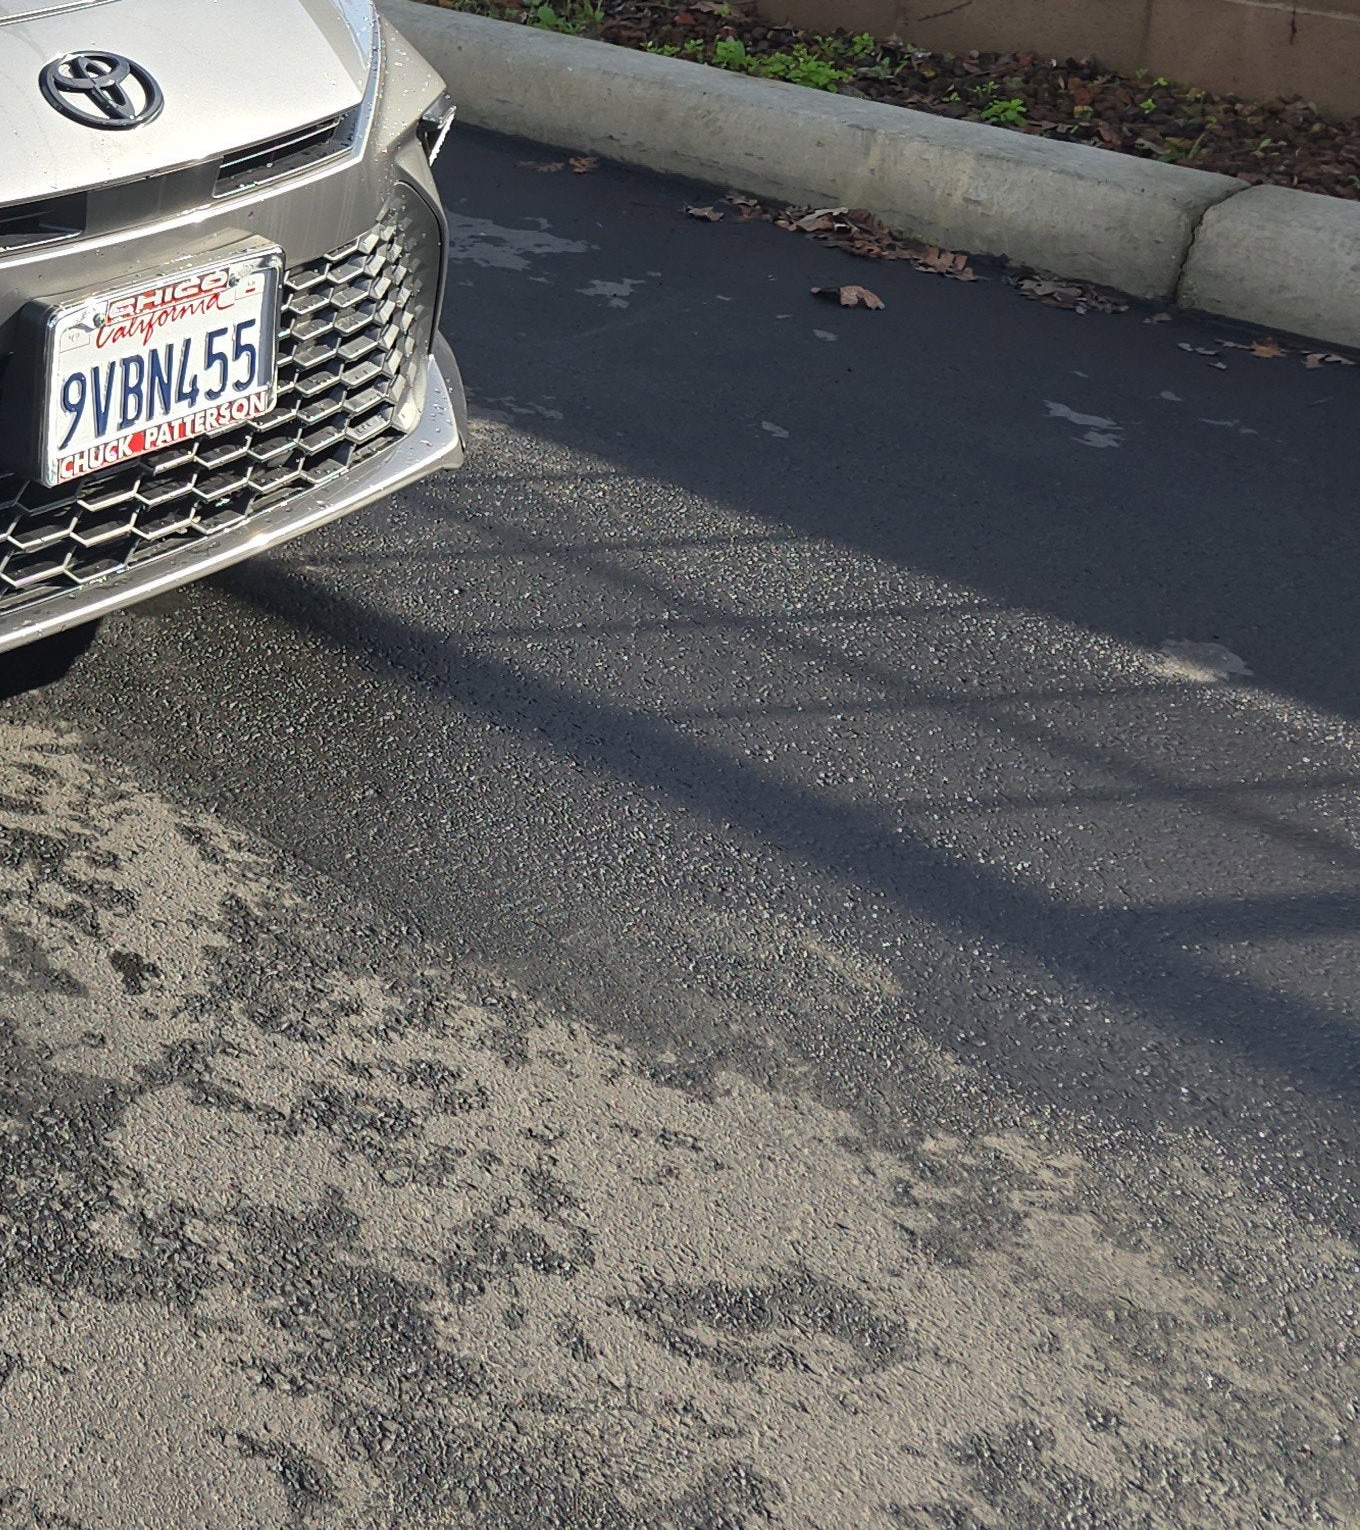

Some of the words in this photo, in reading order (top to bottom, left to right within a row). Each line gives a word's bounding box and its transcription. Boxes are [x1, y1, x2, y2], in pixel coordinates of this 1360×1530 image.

[96, 293, 235, 348] California
[108, 273, 228, 319] CHICO
[61, 319, 257, 450] 9VBN455
[60, 435, 134, 478] CHUCK
[144, 392, 267, 450] PATTERSON
